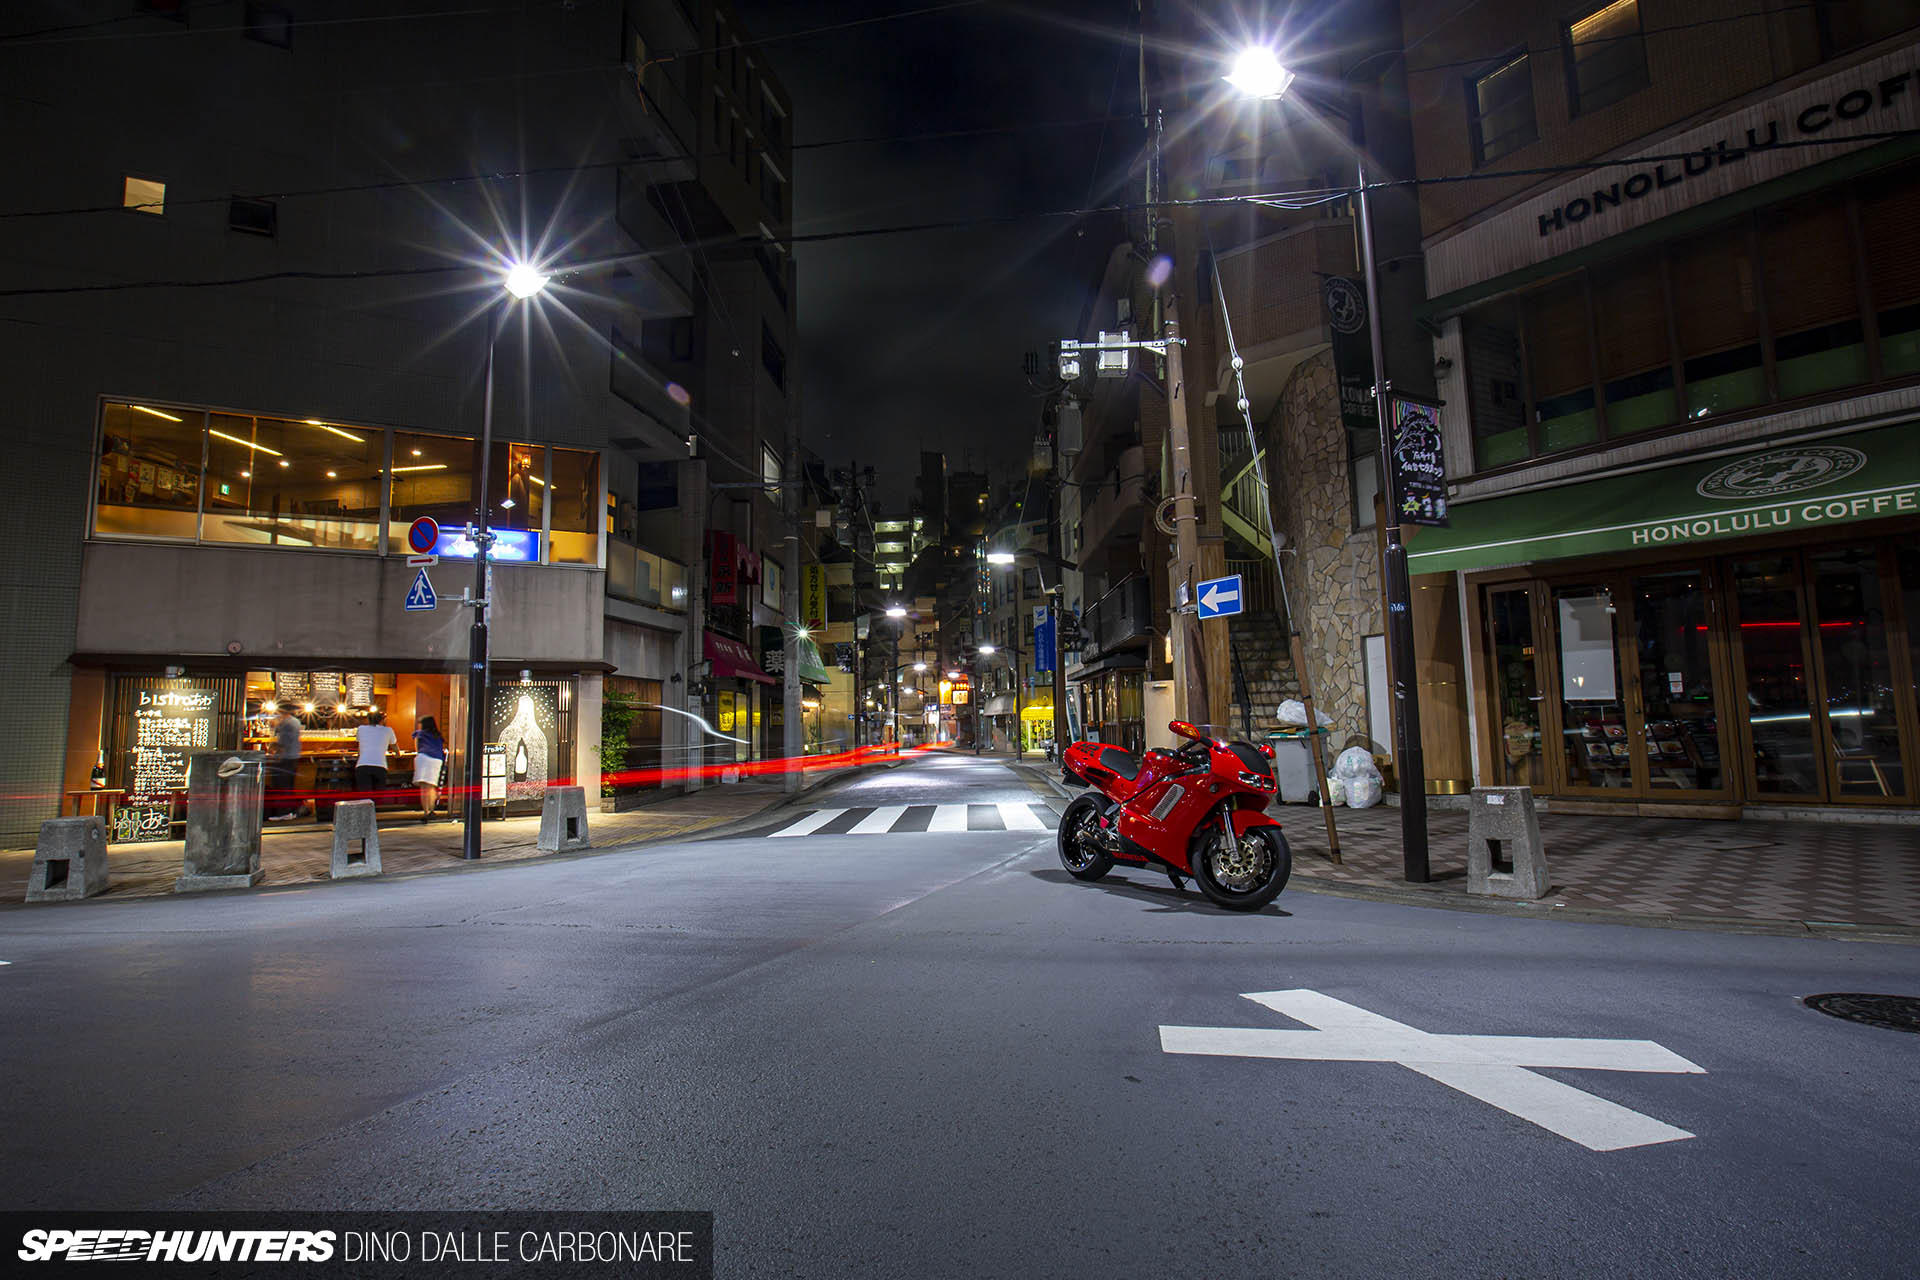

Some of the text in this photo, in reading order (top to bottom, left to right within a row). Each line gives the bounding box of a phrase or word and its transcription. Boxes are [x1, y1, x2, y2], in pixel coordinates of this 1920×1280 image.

[1538, 68, 1920, 237] HONOLULU COF
[1631, 492, 1920, 544] HONOLULU COFFE
